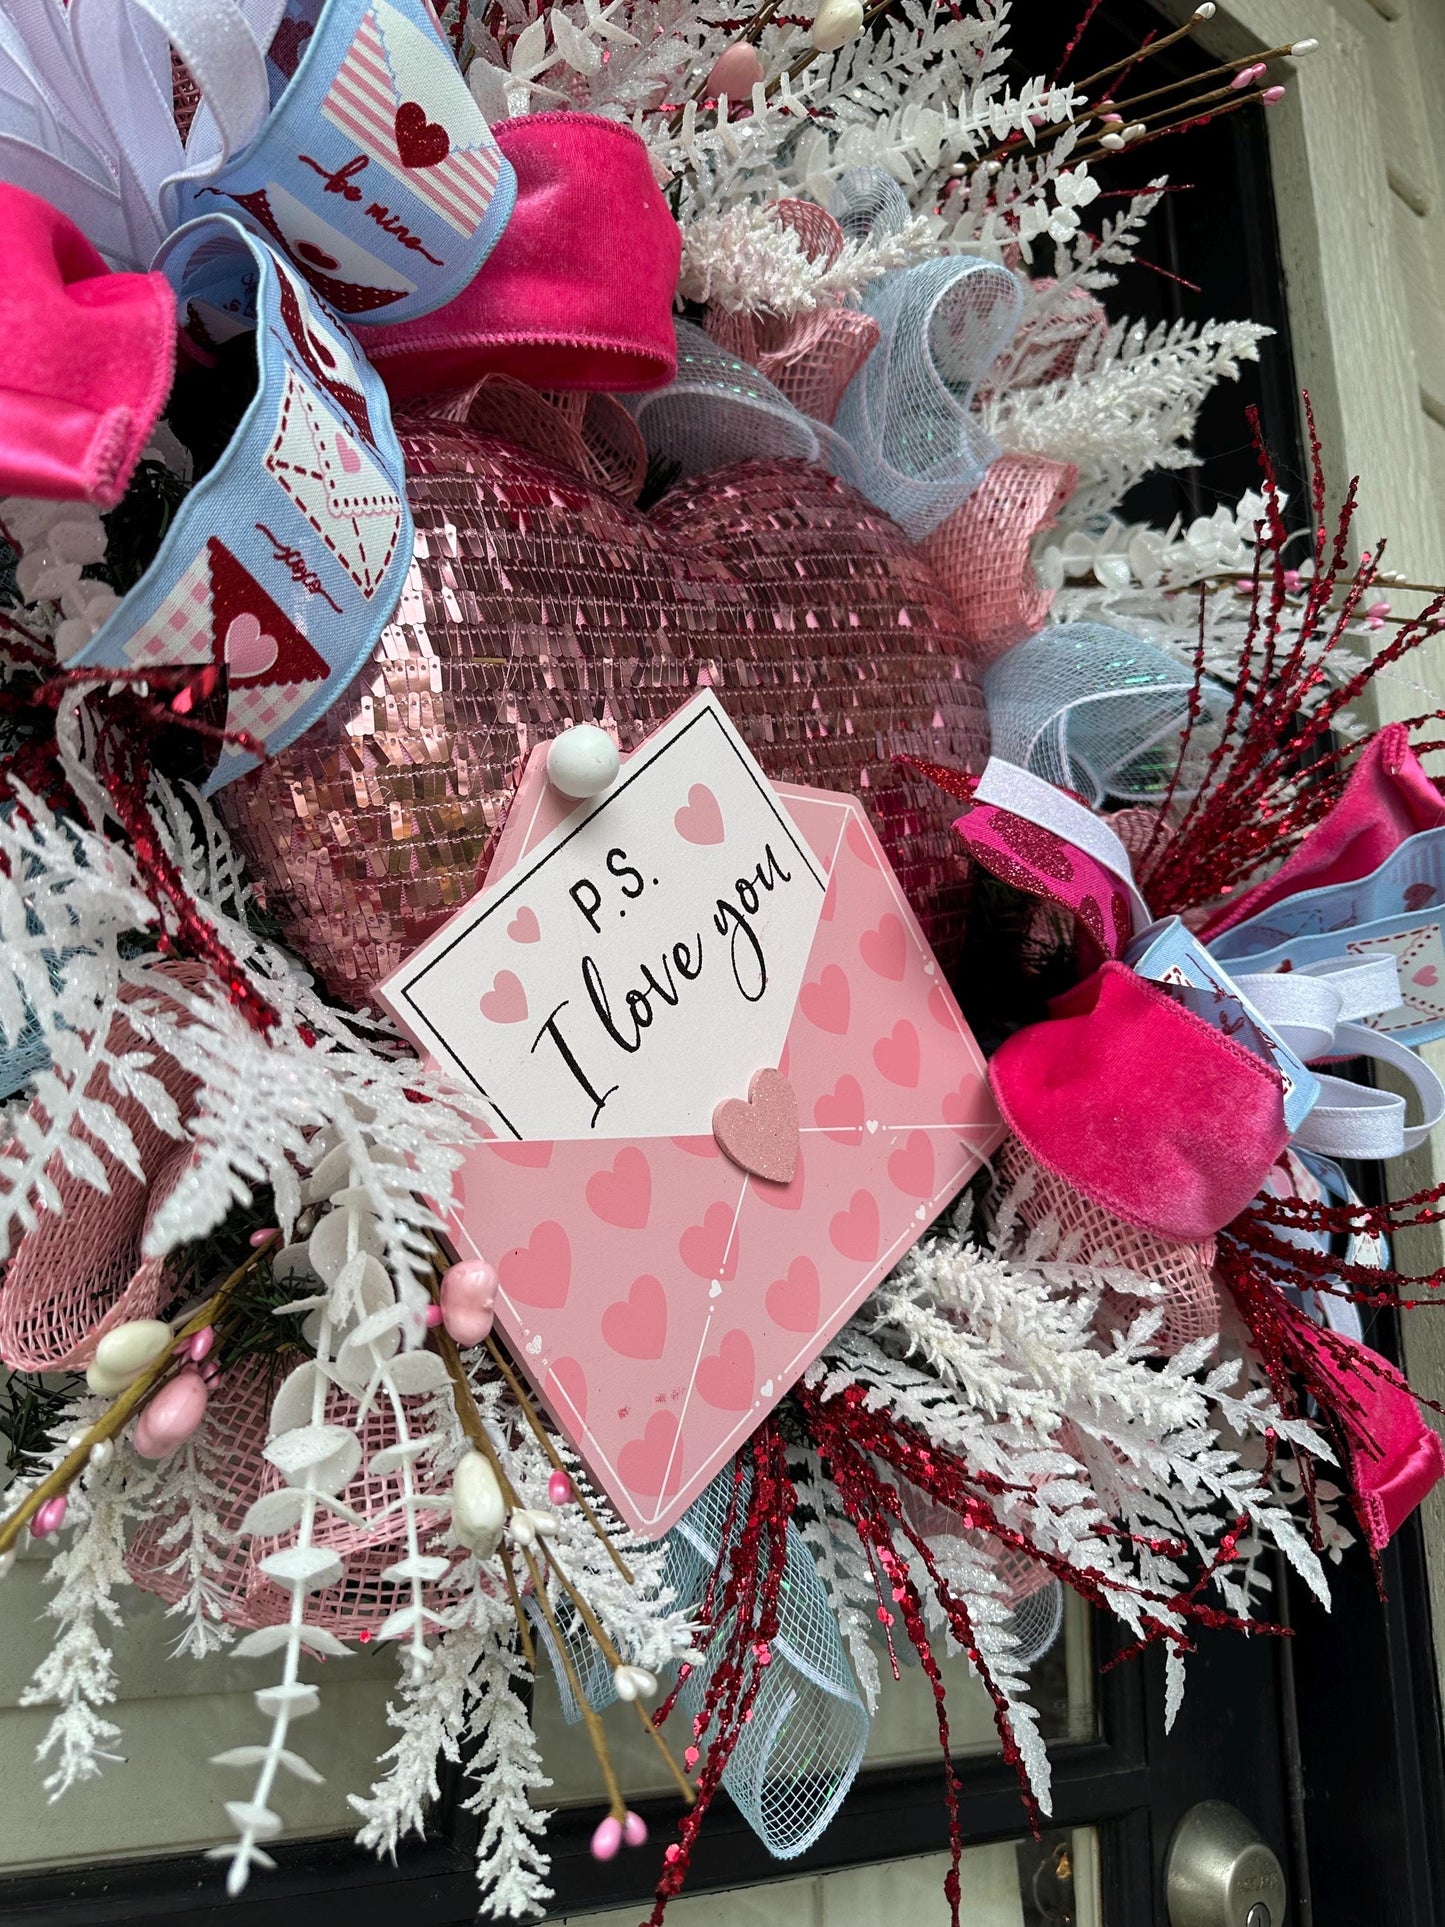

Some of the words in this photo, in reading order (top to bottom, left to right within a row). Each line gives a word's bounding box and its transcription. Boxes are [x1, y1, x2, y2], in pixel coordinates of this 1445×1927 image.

[298, 154, 369, 202] be
[364, 202, 444, 267] mine
[254, 523, 343, 614] xoxo
[568, 847, 659, 934] P.S.
[530, 1000, 619, 1129] I
[581, 932, 703, 1054] love
[712, 843, 792, 1002] you
